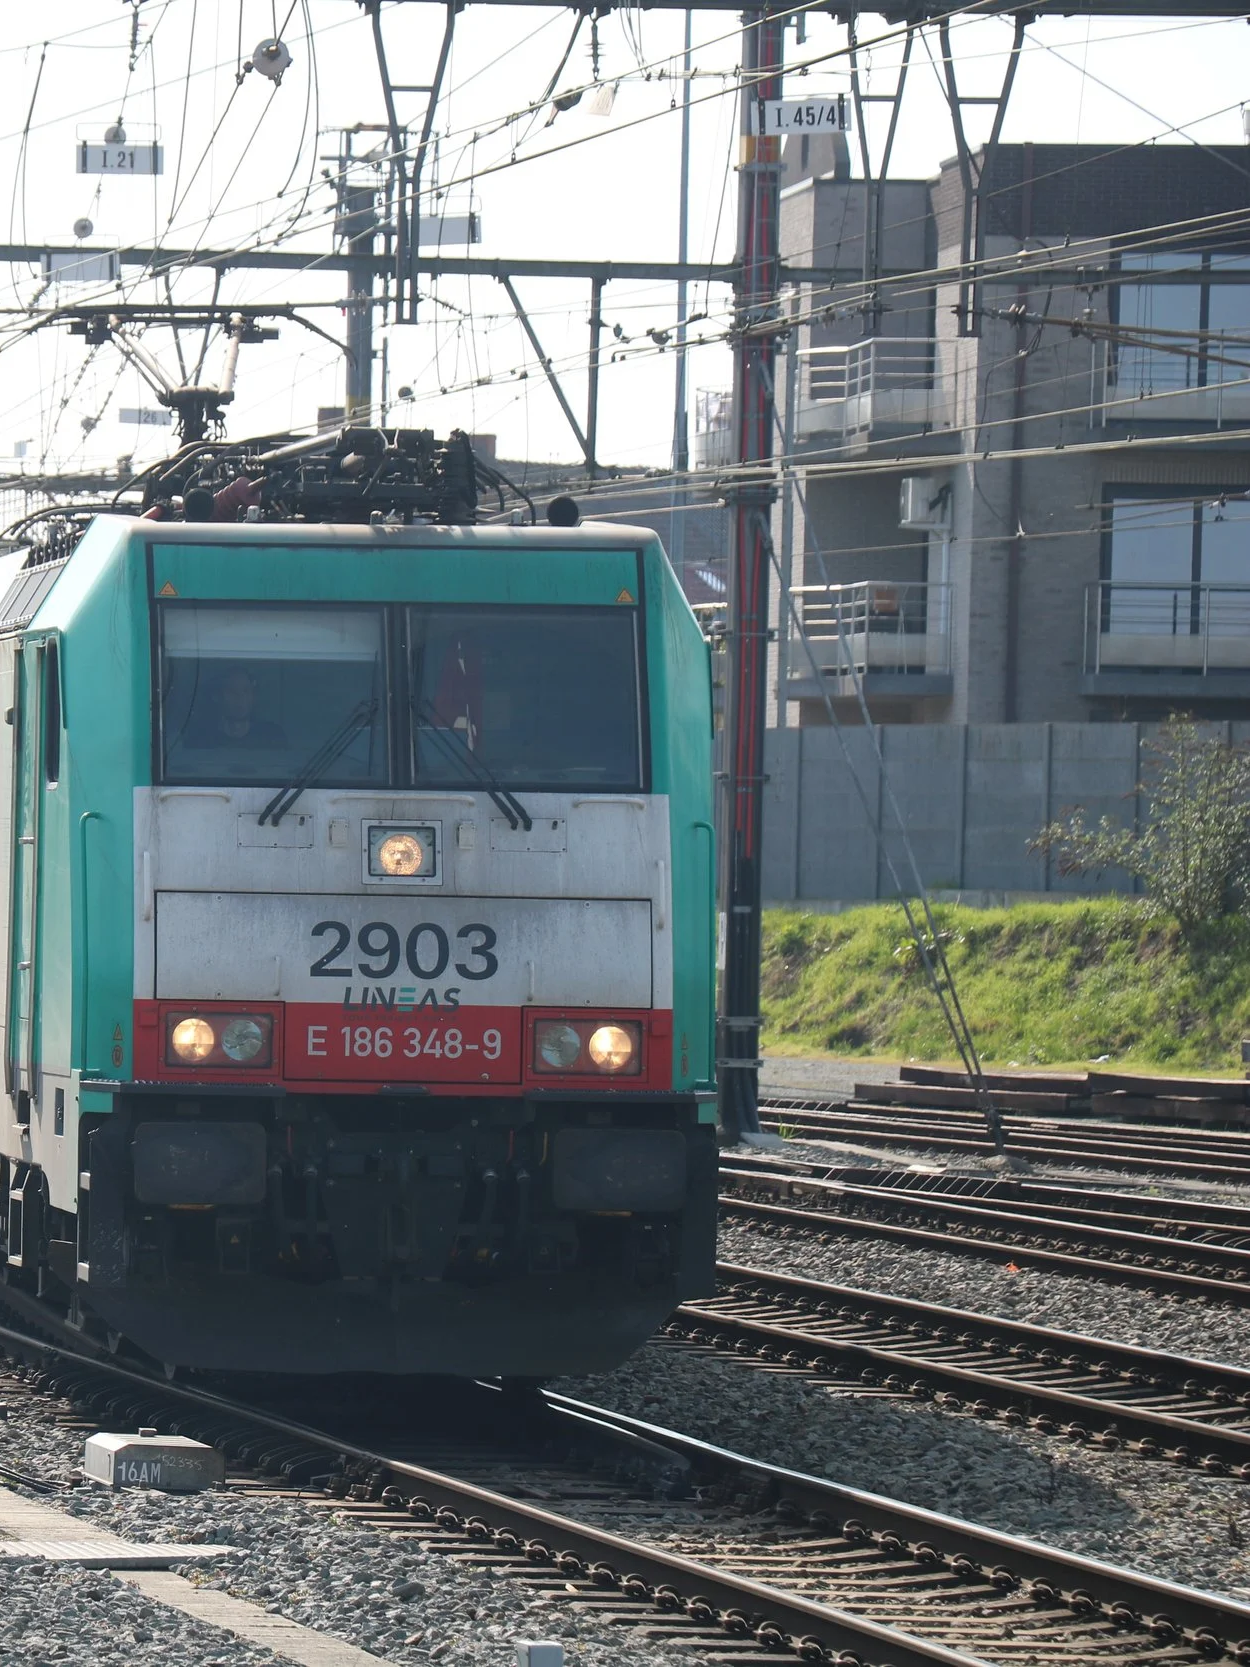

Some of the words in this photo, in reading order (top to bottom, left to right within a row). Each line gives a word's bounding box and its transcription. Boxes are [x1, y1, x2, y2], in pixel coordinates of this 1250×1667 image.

[775, 105, 837, 127] I.45/4
[101, 149, 134, 168] I.21
[310, 920, 498, 981] 2903
[342, 986, 461, 1013] LINEAS
[307, 1025, 328, 1056] E
[341, 1026, 393, 1058] 186
[403, 1027, 502, 1060] 348-9
[118, 1461, 162, 1484] 16AM
